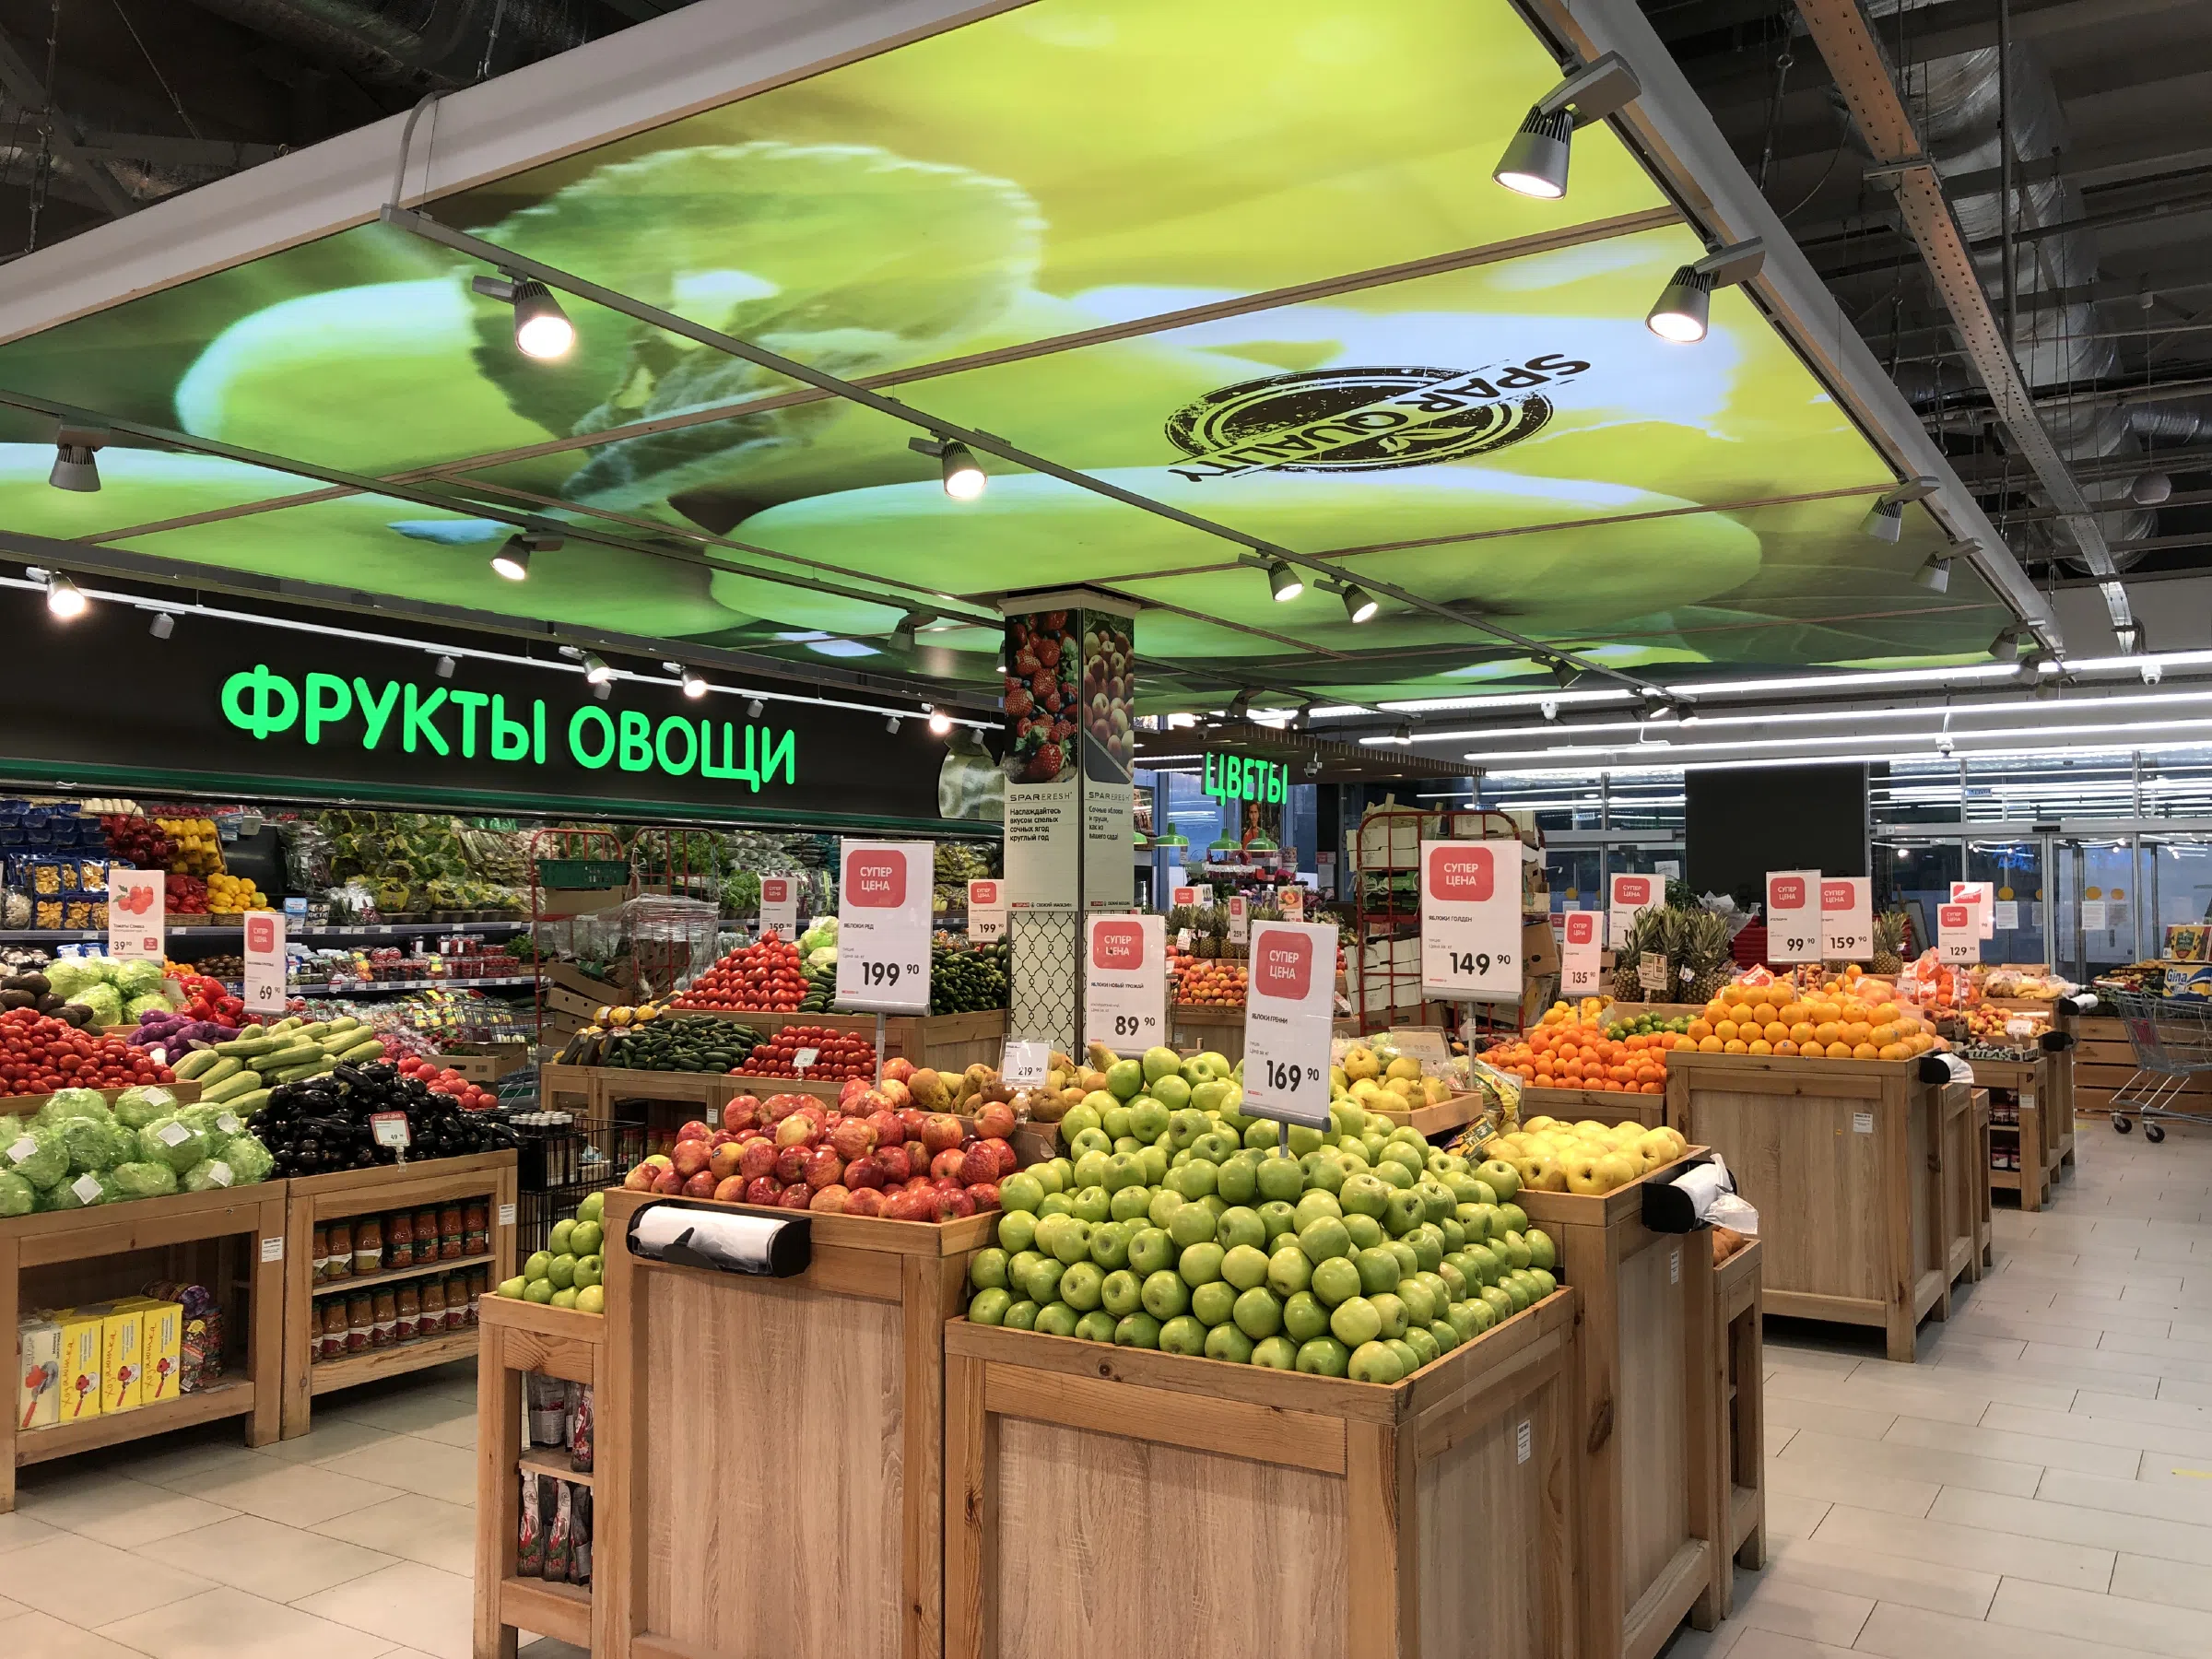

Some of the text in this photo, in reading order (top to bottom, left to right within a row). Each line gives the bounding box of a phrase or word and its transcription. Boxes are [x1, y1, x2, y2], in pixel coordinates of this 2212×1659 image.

[1167, 353, 1592, 483] SPAR QUALITY
[221, 664, 795, 794] ФРУКТЫ ОВОЩИ
[1205, 751, 1288, 806] ЦВЕТЫ
[1009, 807, 1062, 816] Наслаждайтесь
[1009, 834, 1037, 842] круглый
[859, 866, 893, 877] СУПЕР
[1443, 863, 1478, 873] СУПЕР
[861, 880, 890, 892] ЦЕНА
[1445, 875, 1477, 887] ЦЕНА
[1779, 893, 1795, 901] ЦЕНА
[979, 924, 996, 934] 199
[113, 941, 125, 950] 39
[1104, 935, 1133, 945] СУПЕР
[1786, 938, 1804, 951] 99
[1830, 936, 1855, 949] 159
[1105, 947, 1130, 957] ЦЕНА
[1269, 949, 1300, 964] СУПЕР
[1949, 947, 1967, 956] 129
[1449, 952, 1511, 976] 149 90
[862, 961, 920, 987] 199 90
[1269, 965, 1296, 980] ЦЕНА
[1571, 971, 1588, 983] 135
[2167, 969, 2188, 983] Gina
[259, 985, 272, 1000] 69
[1251, 1013, 1270, 1022] ЯБЛОКИ
[1114, 1015, 1156, 1037] 89 90
[1018, 1066, 1033, 1076] 219
[1266, 1060, 1320, 1092] 169 90
